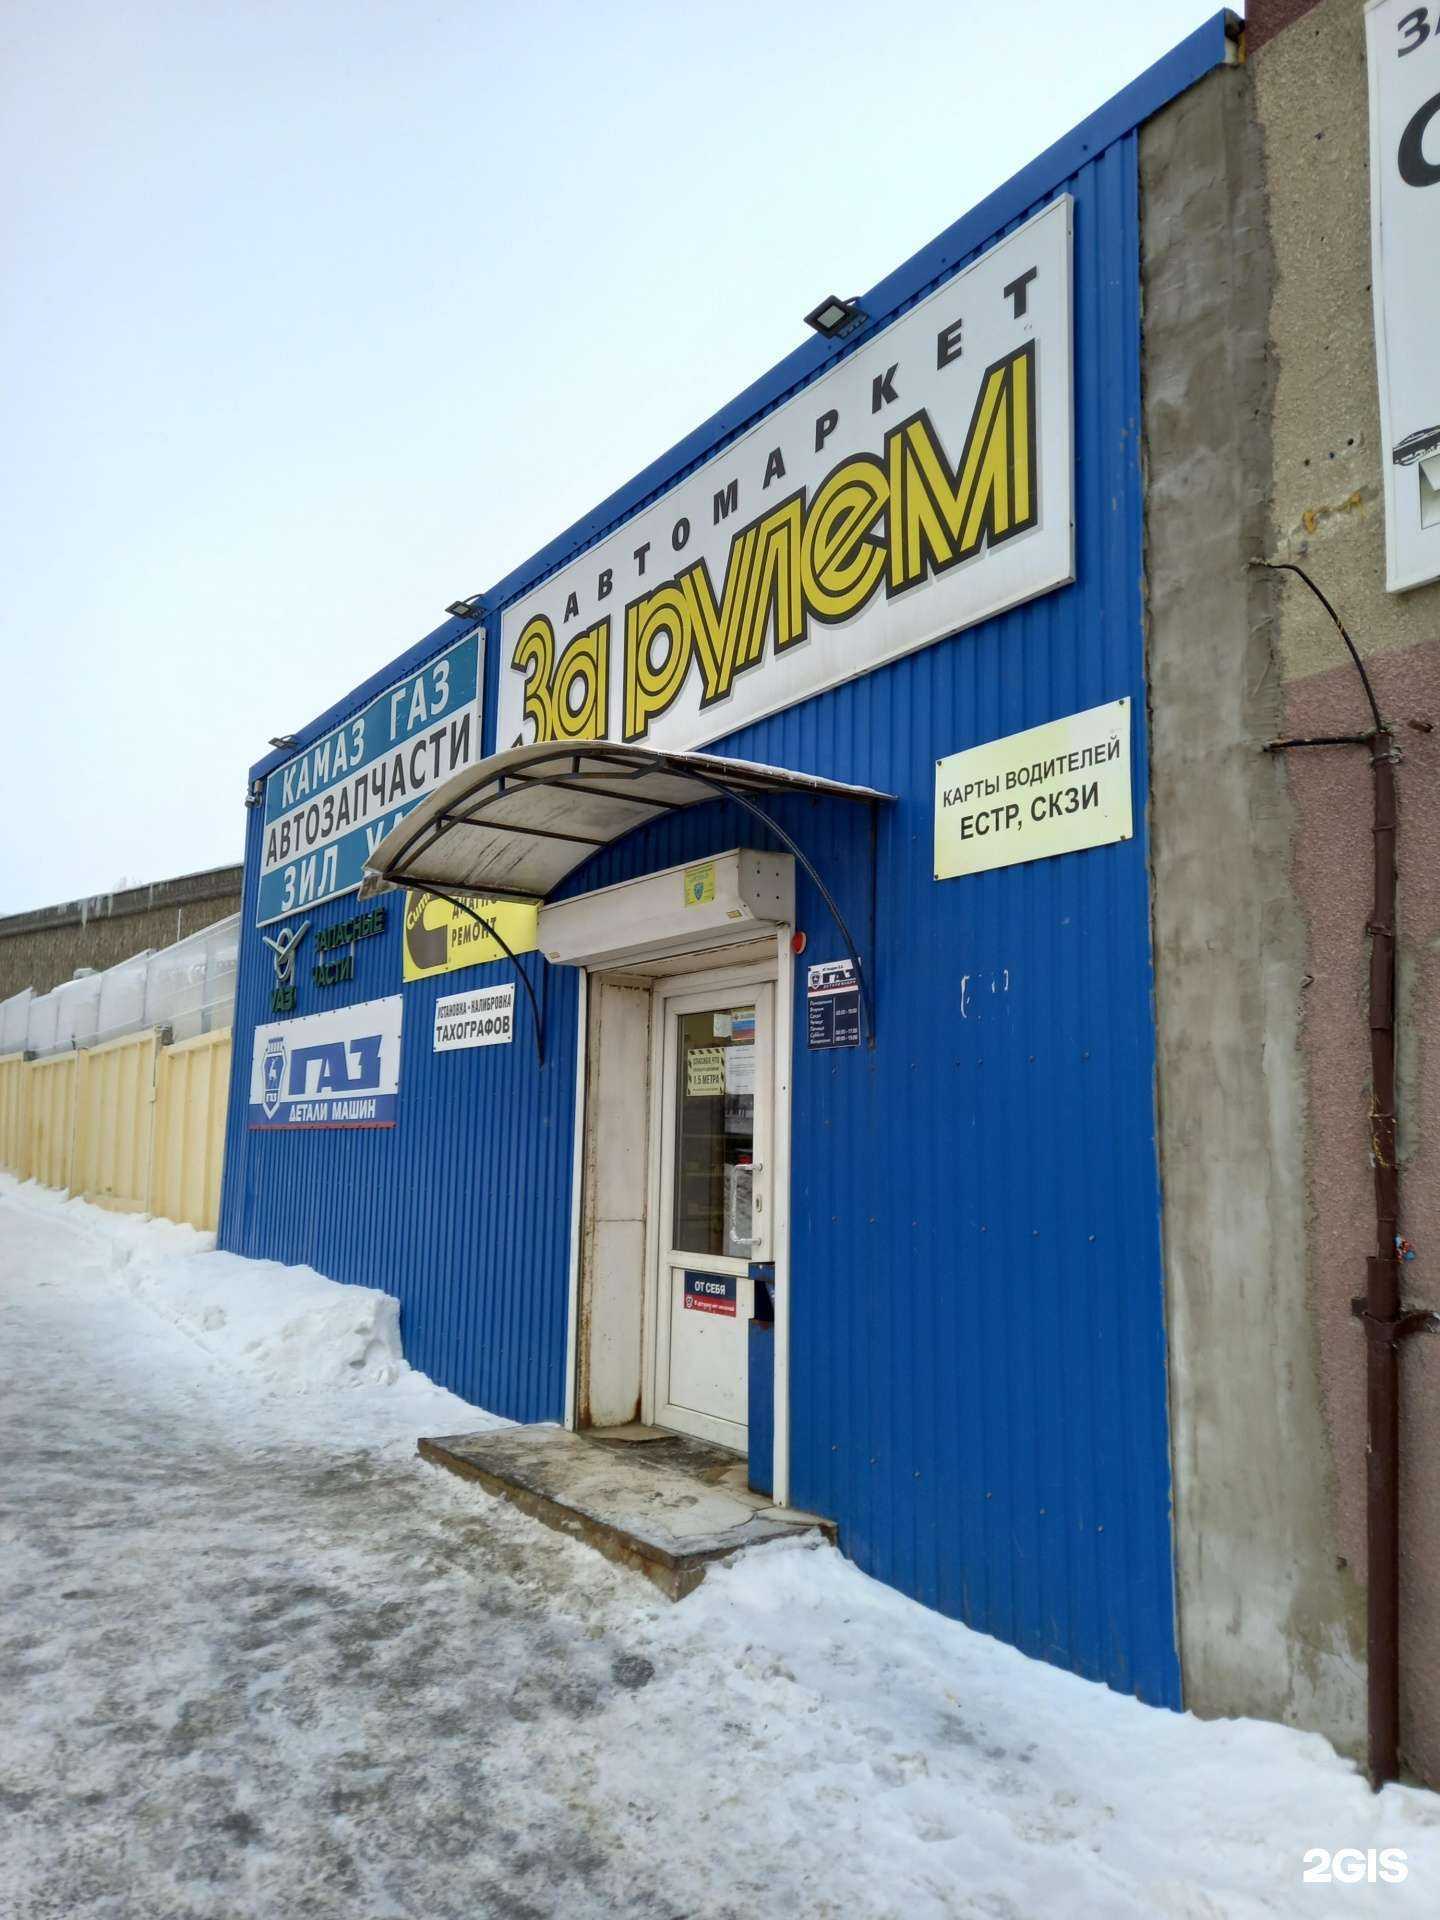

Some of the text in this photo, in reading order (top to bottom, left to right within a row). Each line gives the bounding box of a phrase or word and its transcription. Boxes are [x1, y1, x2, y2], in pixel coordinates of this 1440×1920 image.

[563, 266, 1037, 624] АВТОМАРКЕТ
[511, 613, 611, 743] За
[281, 659, 451, 809] КАМАЗ ГАЗ
[265, 713, 471, 868] АВТОЗАПЧАСТИ
[943, 735, 1120, 808] КАРТЫ ВОДИТЕЛЕЙ
[960, 781, 1099, 840] ЕСТР, СКЗИ
[280, 844, 338, 912] ЗИЛ
[436, 1015, 510, 1043] ТАХОГРАФОВ
[288, 1034, 382, 1095] ГАЗ
[288, 1099, 377, 1122] ДЕТАЛИ МАШИН
[694, 1281, 726, 1296] ОТ СЕБЯ
